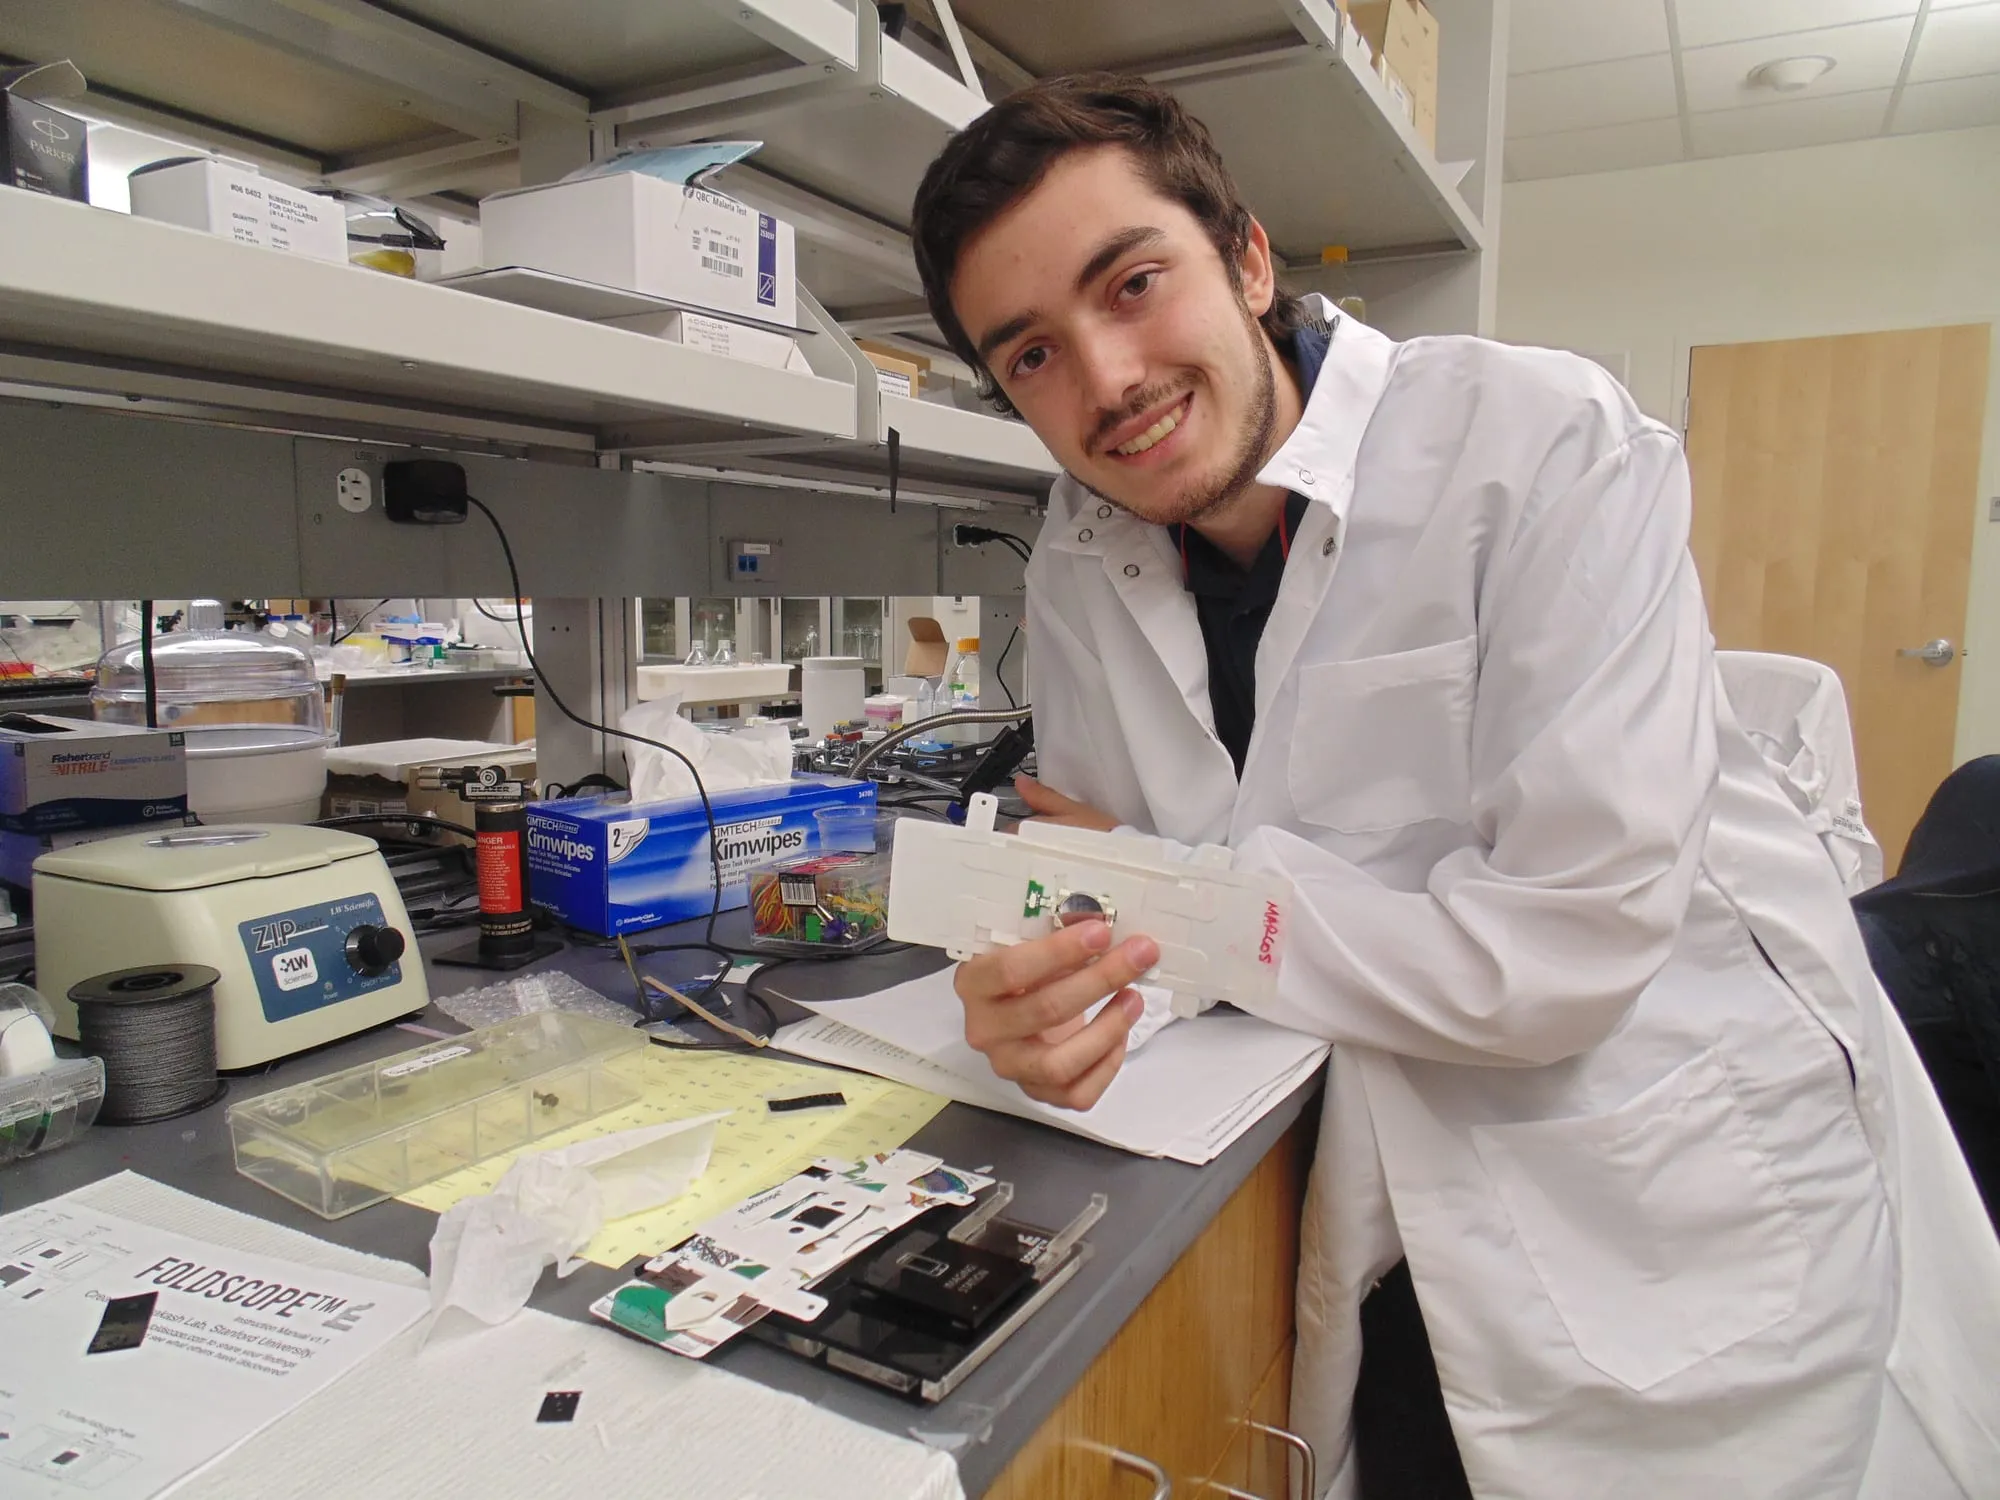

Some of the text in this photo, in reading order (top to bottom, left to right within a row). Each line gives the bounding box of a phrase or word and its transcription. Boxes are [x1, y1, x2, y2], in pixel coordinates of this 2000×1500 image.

[30, 139, 75, 164] PARKER
[268, 194, 308, 212] RUBBER CAPS
[268, 202, 281, 210] FOR
[713, 195, 735, 214] Malaria
[736, 203, 748, 216] Test
[51, 751, 112, 764] Fisherbrand
[55, 761, 109, 776] NITRILE
[470, 785, 510, 793] BLAZER
[477, 836, 504, 845] ANGER
[612, 828, 621, 848] 2
[344, 899, 377, 913] Scientific
[1258, 899, 1280, 964] MARCOS
[289, 953, 309, 973] LW
[283, 971, 314, 986] Scientific
[209, 1324, 260, 1342] Stanford
[232, 1315, 278, 1331] Instruction
[277, 1327, 312, 1340] Manual
